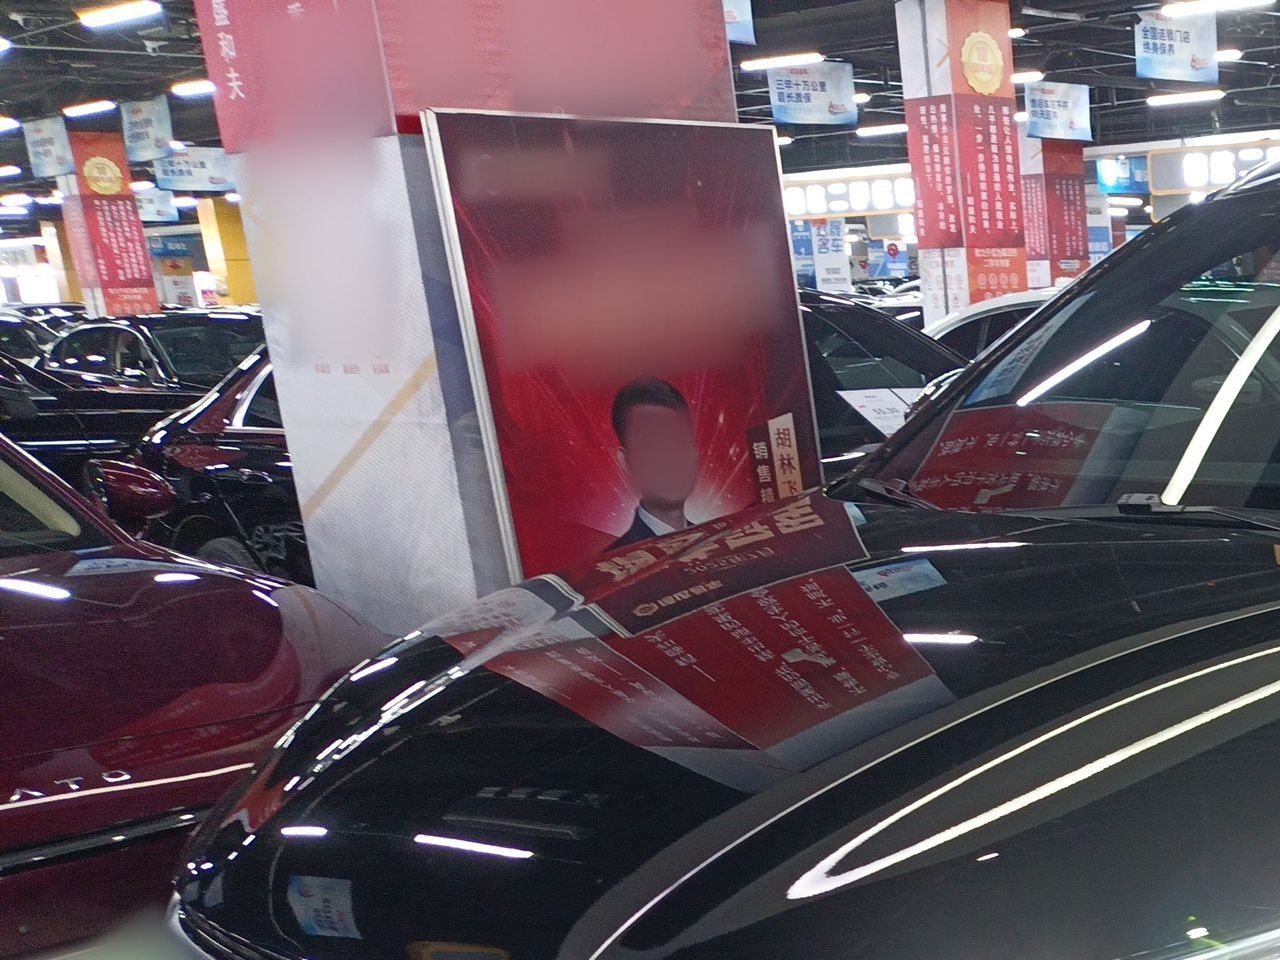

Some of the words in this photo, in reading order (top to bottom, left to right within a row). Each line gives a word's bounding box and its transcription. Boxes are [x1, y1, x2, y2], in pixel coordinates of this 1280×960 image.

[775, 79, 828, 92] 三年十万公里
